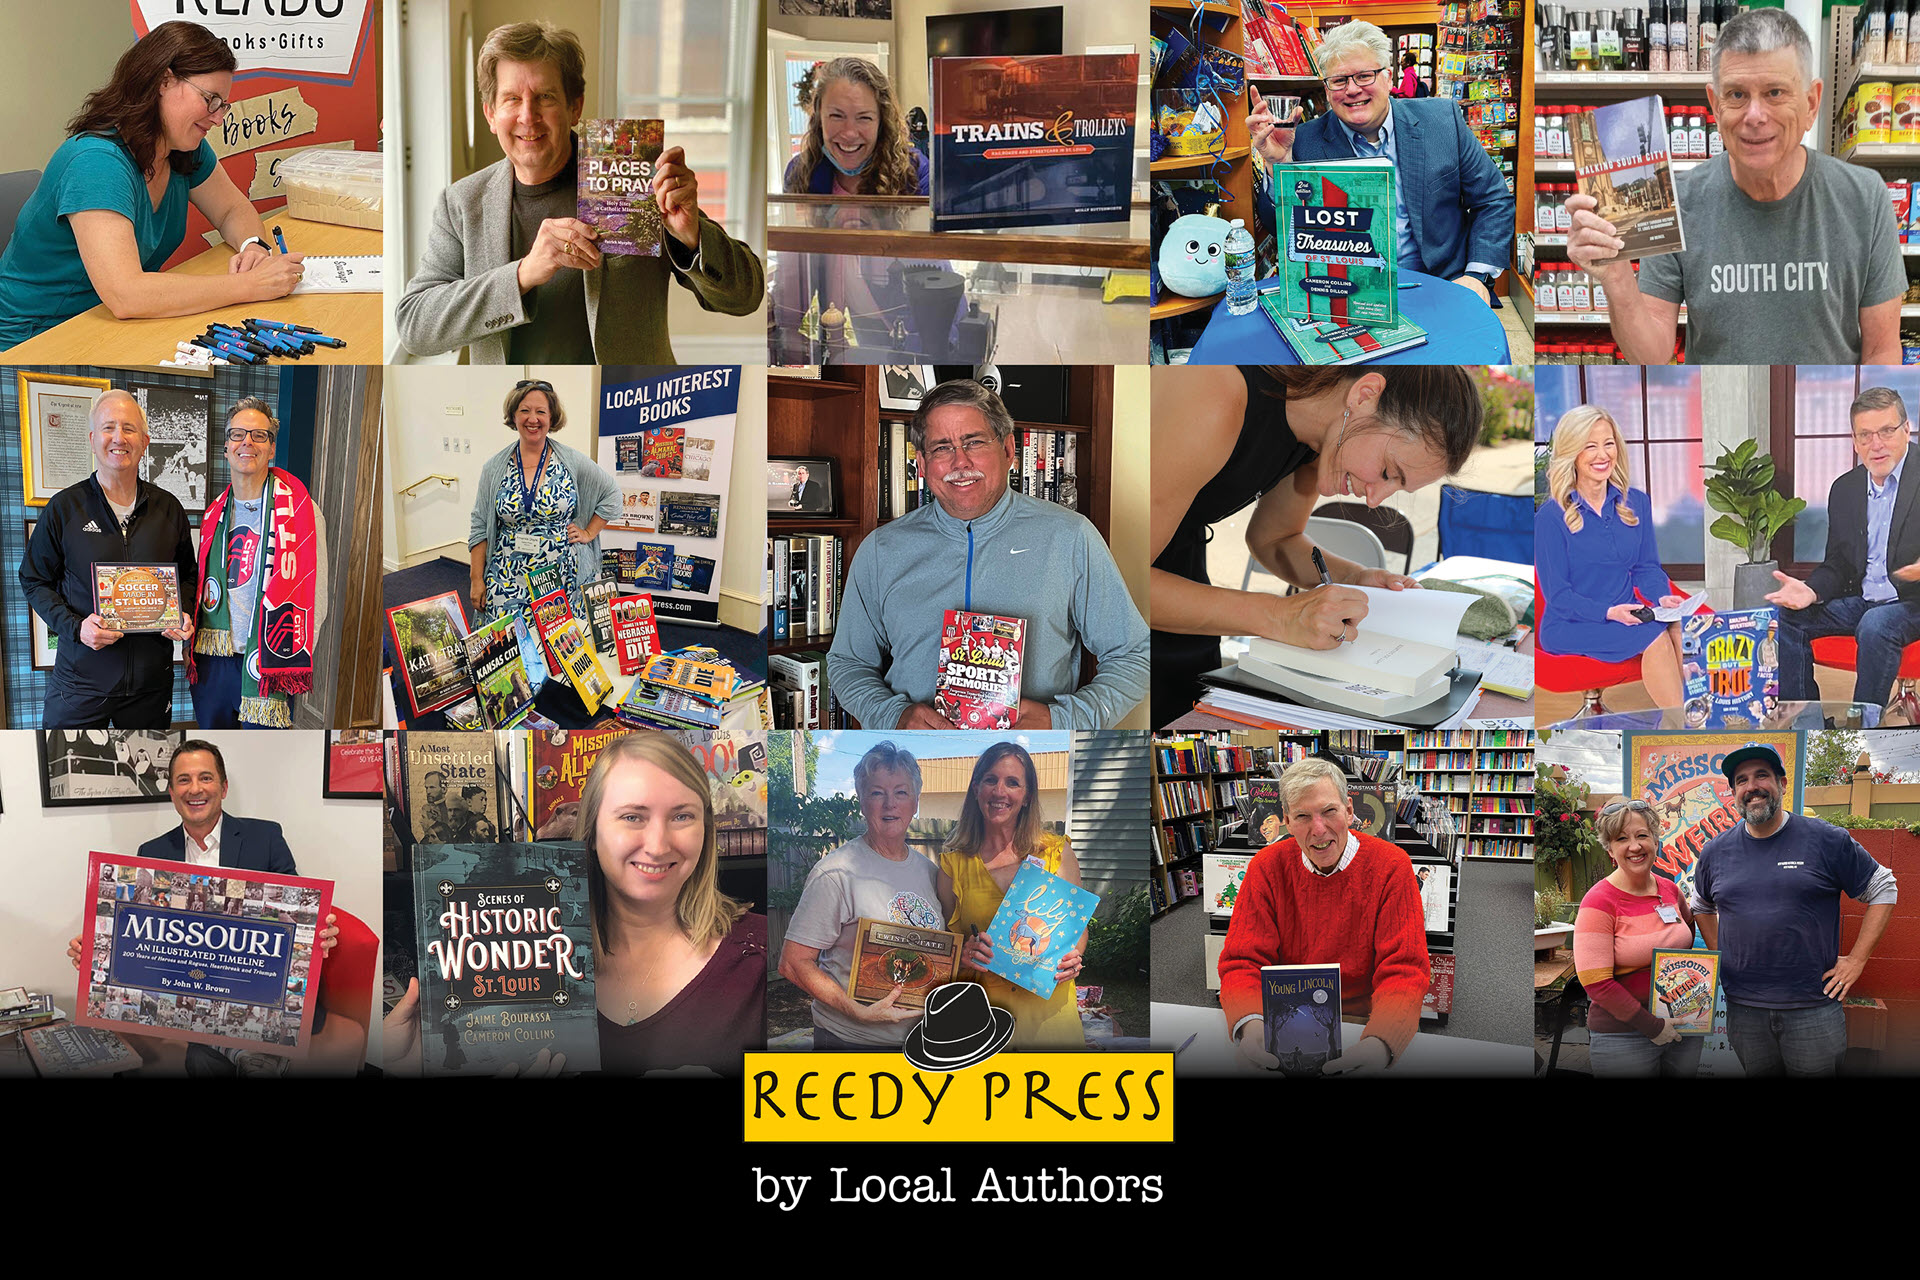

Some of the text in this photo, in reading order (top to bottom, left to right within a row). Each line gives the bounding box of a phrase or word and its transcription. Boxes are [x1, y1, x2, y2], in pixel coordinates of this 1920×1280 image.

[279, 33, 324, 49] Gifts
[223, 98, 296, 146] Books
[951, 110, 1127, 147] TRAINS & TROLLEYS
[589, 161, 651, 176] PLACES
[1578, 150, 1664, 176] WALKING SOUTH CITY
[586, 176, 653, 193] TO PRAY
[1298, 181, 1309, 189] 2nd
[1305, 209, 1359, 226] LOST
[1296, 232, 1373, 253] Treasures
[1306, 254, 1318, 262] OF
[1336, 257, 1364, 265] LOUIS
[1710, 261, 1828, 294] SOUTH CITY
[606, 368, 733, 410] LOCAL INTEREST
[639, 396, 692, 425] BOOKS
[650, 445, 678, 456] ALMANAC
[1024, 437, 1029, 445] MY
[684, 454, 712, 462] CHICAGO
[630, 513, 654, 521] BROWNS
[240, 538, 253, 577] CITY
[530, 567, 558, 587] WHAT'S
[537, 580, 556, 596] WITH
[585, 581, 618, 606] 100
[115, 598, 164, 606] ST. LOUIS
[534, 595, 568, 626] 100
[611, 598, 652, 623] 100
[294, 614, 302, 646] CITY
[1729, 616, 1749, 624] AMAZING
[617, 624, 656, 640] NEBRASKA
[625, 637, 641, 645] BEFORE
[472, 631, 495, 655] SECRET
[553, 625, 585, 661] 100
[625, 640, 653, 661] DIE
[1706, 634, 1755, 663] CRAZY
[409, 640, 464, 672] KATY TRAI
[476, 654, 504, 680] KANSAS
[504, 645, 519, 661] CITY
[571, 652, 593, 678] IOWA
[951, 647, 1005, 668] St. Louis
[648, 657, 678, 681] 100
[694, 668, 715, 688] DIE
[946, 662, 1009, 684] SPORTS
[1757, 671, 1774, 679] FACTS!
[945, 675, 1009, 694] MEMORIES
[1686, 676, 1707, 686] AWESOME
[1707, 667, 1753, 698] TRUE
[1732, 691, 1754, 705] HISTORY
[701, 730, 731, 743] Louis
[340, 748, 364, 756] Celebrate
[410, 750, 494, 765] Unsettled
[420, 744, 450, 753] A Most
[440, 763, 486, 779] State
[477, 892, 525, 907] SCENES OF
[439, 901, 562, 940] HISTORIC
[1017, 884, 1068, 939] lily
[121, 913, 285, 958] MISSOURI
[877, 932, 944, 949] TWIST FATE
[122, 950, 135, 958] 200
[135, 952, 150, 960] Years
[157, 955, 177, 964] Heroes
[187, 959, 209, 968] Rogues,
[210, 962, 240, 972] Heartbreak
[241, 966, 252, 974] and
[253, 968, 277, 977] Triumph
[135, 943, 265, 968] AN ILLUSTRATED TIMELINE
[427, 933, 584, 981] WONDER
[1661, 959, 1710, 978] MISSOURI
[161, 977, 231, 994] By John W. Brown
[472, 974, 541, 997] ST. LOUIS
[1268, 977, 1334, 996] YOUNG LINCOLN
[1659, 975, 1700, 1004] WEIRD
[466, 1011, 551, 1028] JAIME BOURASSA
[464, 1028, 556, 1045] CAMERON COLLINS
[1719, 1042, 1726, 1050] &
